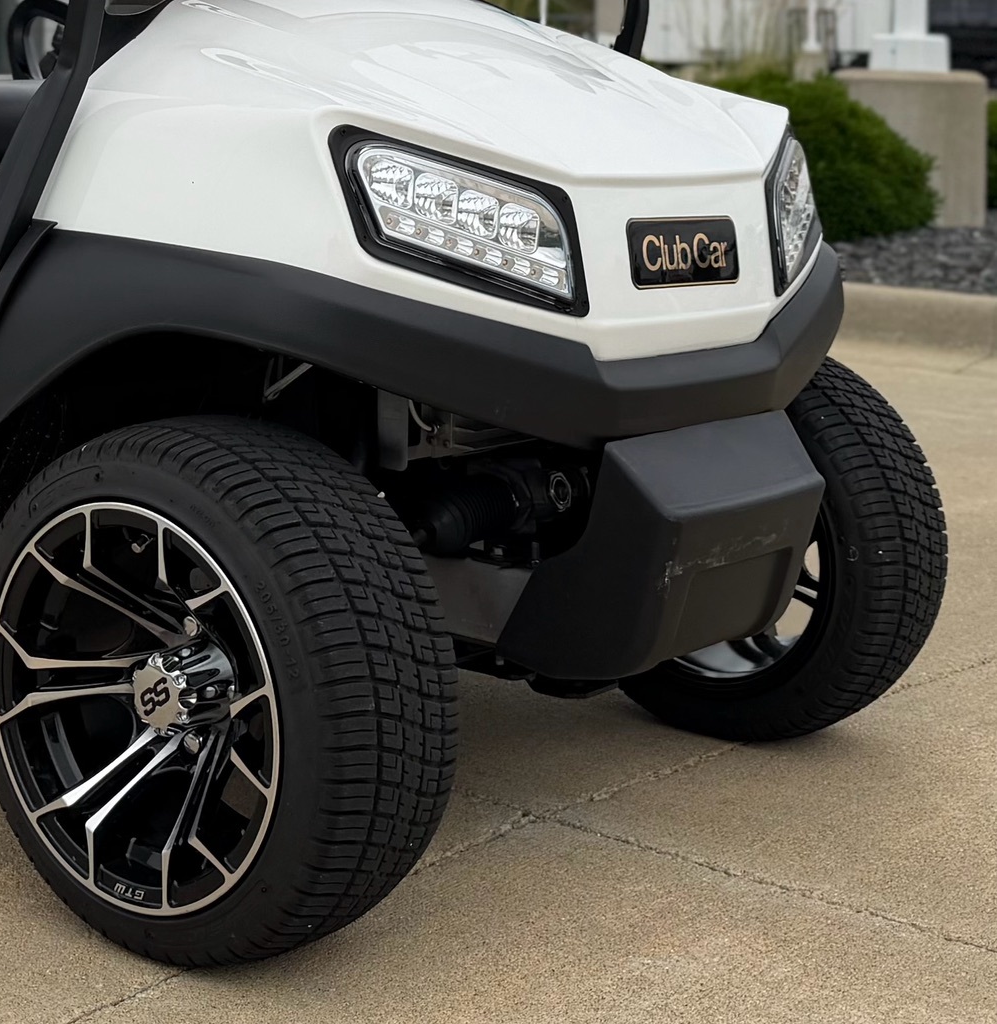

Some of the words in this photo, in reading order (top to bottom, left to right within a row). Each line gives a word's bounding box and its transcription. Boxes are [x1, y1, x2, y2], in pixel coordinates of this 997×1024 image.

[642, 234, 692, 271] Club
[693, 232, 728, 268] Car
[140, 676, 171, 717] SS
[113, 882, 145, 900] GTW
